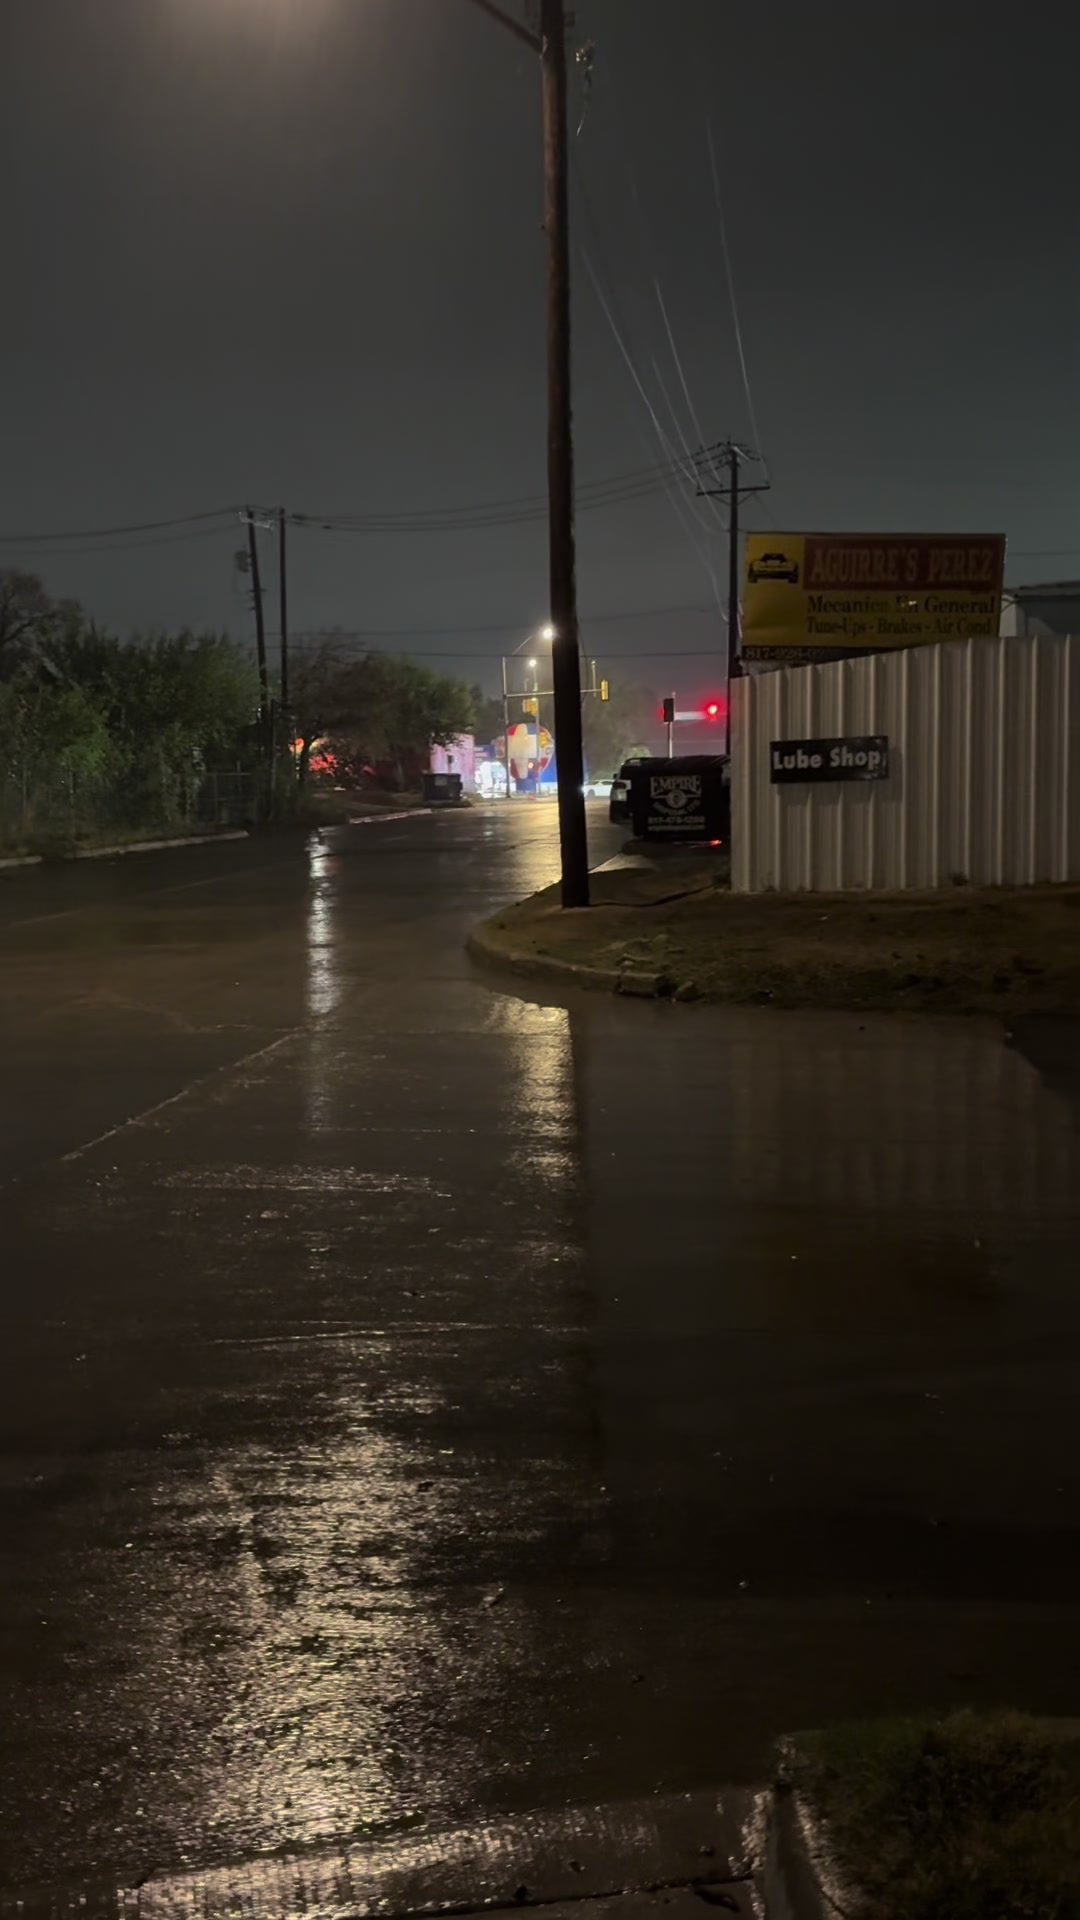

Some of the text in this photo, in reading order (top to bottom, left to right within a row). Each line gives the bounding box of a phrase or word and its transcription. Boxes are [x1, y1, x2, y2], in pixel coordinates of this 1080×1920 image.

[812, 548, 993, 581] AGUIRRE'S PEREZ
[925, 596, 995, 613] General
[808, 617, 991, 636] Tune-Ups Brakes Air Cond
[773, 746, 882, 770] Lube Shop
[650, 775, 702, 796] EMPIRE
